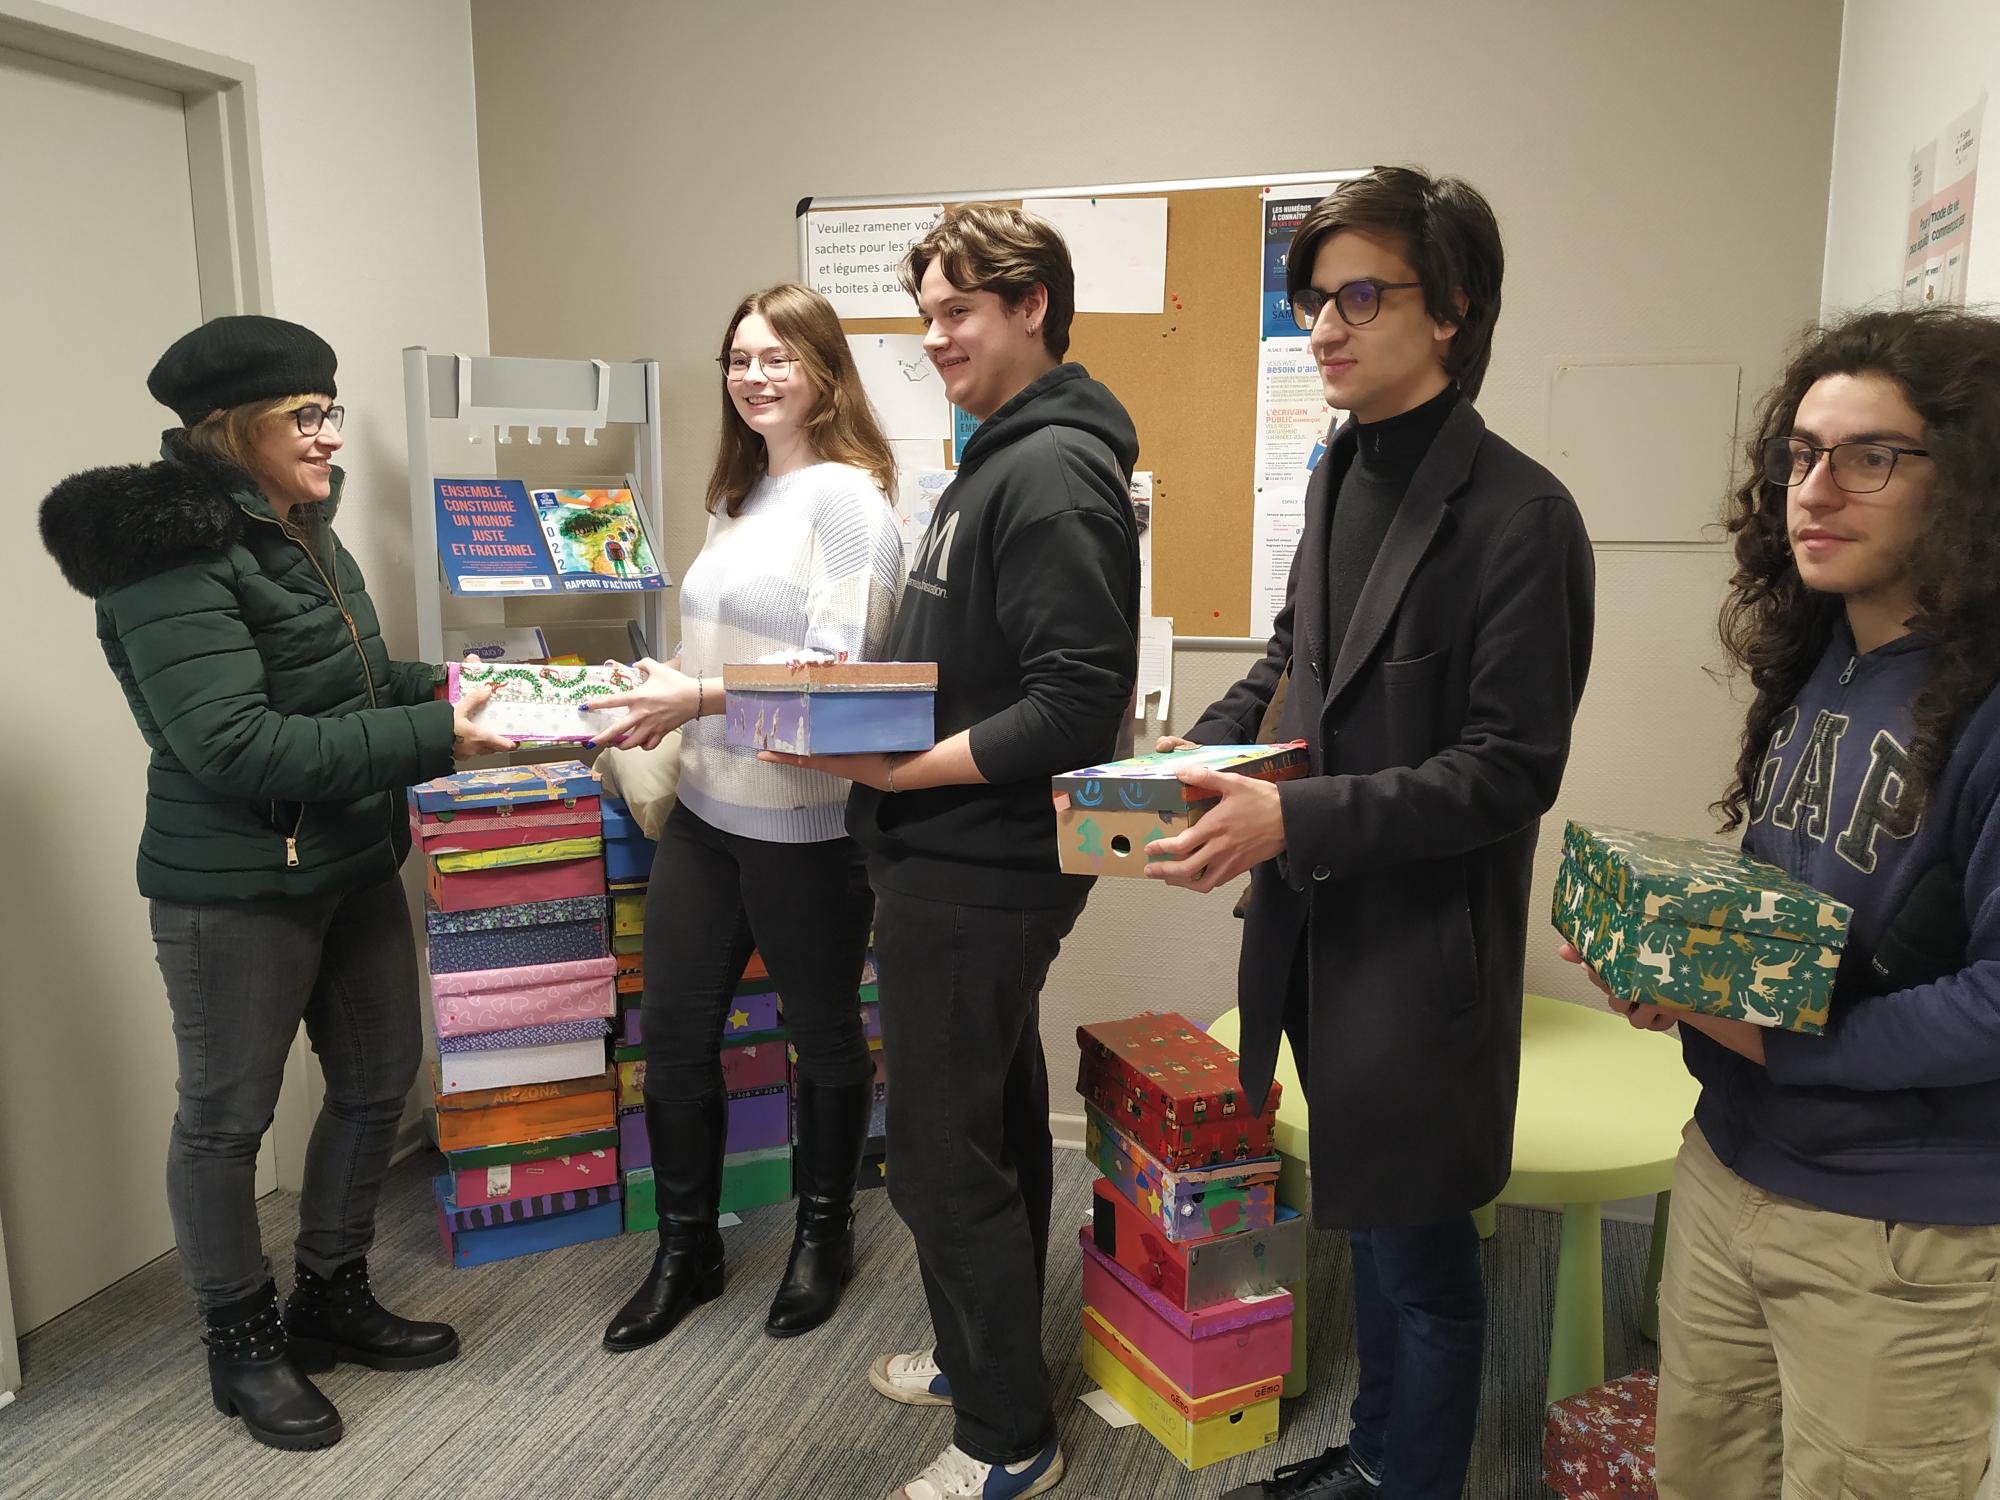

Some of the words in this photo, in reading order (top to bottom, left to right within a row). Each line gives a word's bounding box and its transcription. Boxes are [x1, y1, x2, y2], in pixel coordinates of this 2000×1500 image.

[1272, 206, 1282, 214] LES
[1284, 204, 1312, 212] NUMÉROS
[1272, 212, 1277, 221] À
[1278, 212, 1306, 220] CONNAÎTR
[817, 222, 860, 234] Veuillez
[863, 222, 911, 233] ramener
[914, 220, 934, 230] vos
[815, 244, 856, 254] sachets
[860, 243, 886, 256] pour
[888, 241, 904, 252] les
[819, 265, 830, 275] et
[834, 262, 880, 276] légumes
[817, 282, 832, 294] les
[836, 282, 868, 294] boites
[872, 282, 879, 294] à
[440, 484, 508, 498] ENSEMBLE,
[444, 499, 516, 512] CONSTRUIRE
[452, 514, 470, 527] UN
[472, 514, 515, 527] MONDE
[472, 530, 508, 542] JUSTE
[452, 544, 467, 556] ET
[468, 544, 536, 556] FRATERNEL
[564, 580, 601, 590] RAPPORT
[602, 578, 644, 590] D'ACTIVITÉ
[1749, 705, 1921, 874] GAP
[492, 1085, 560, 1104] ARZONA
